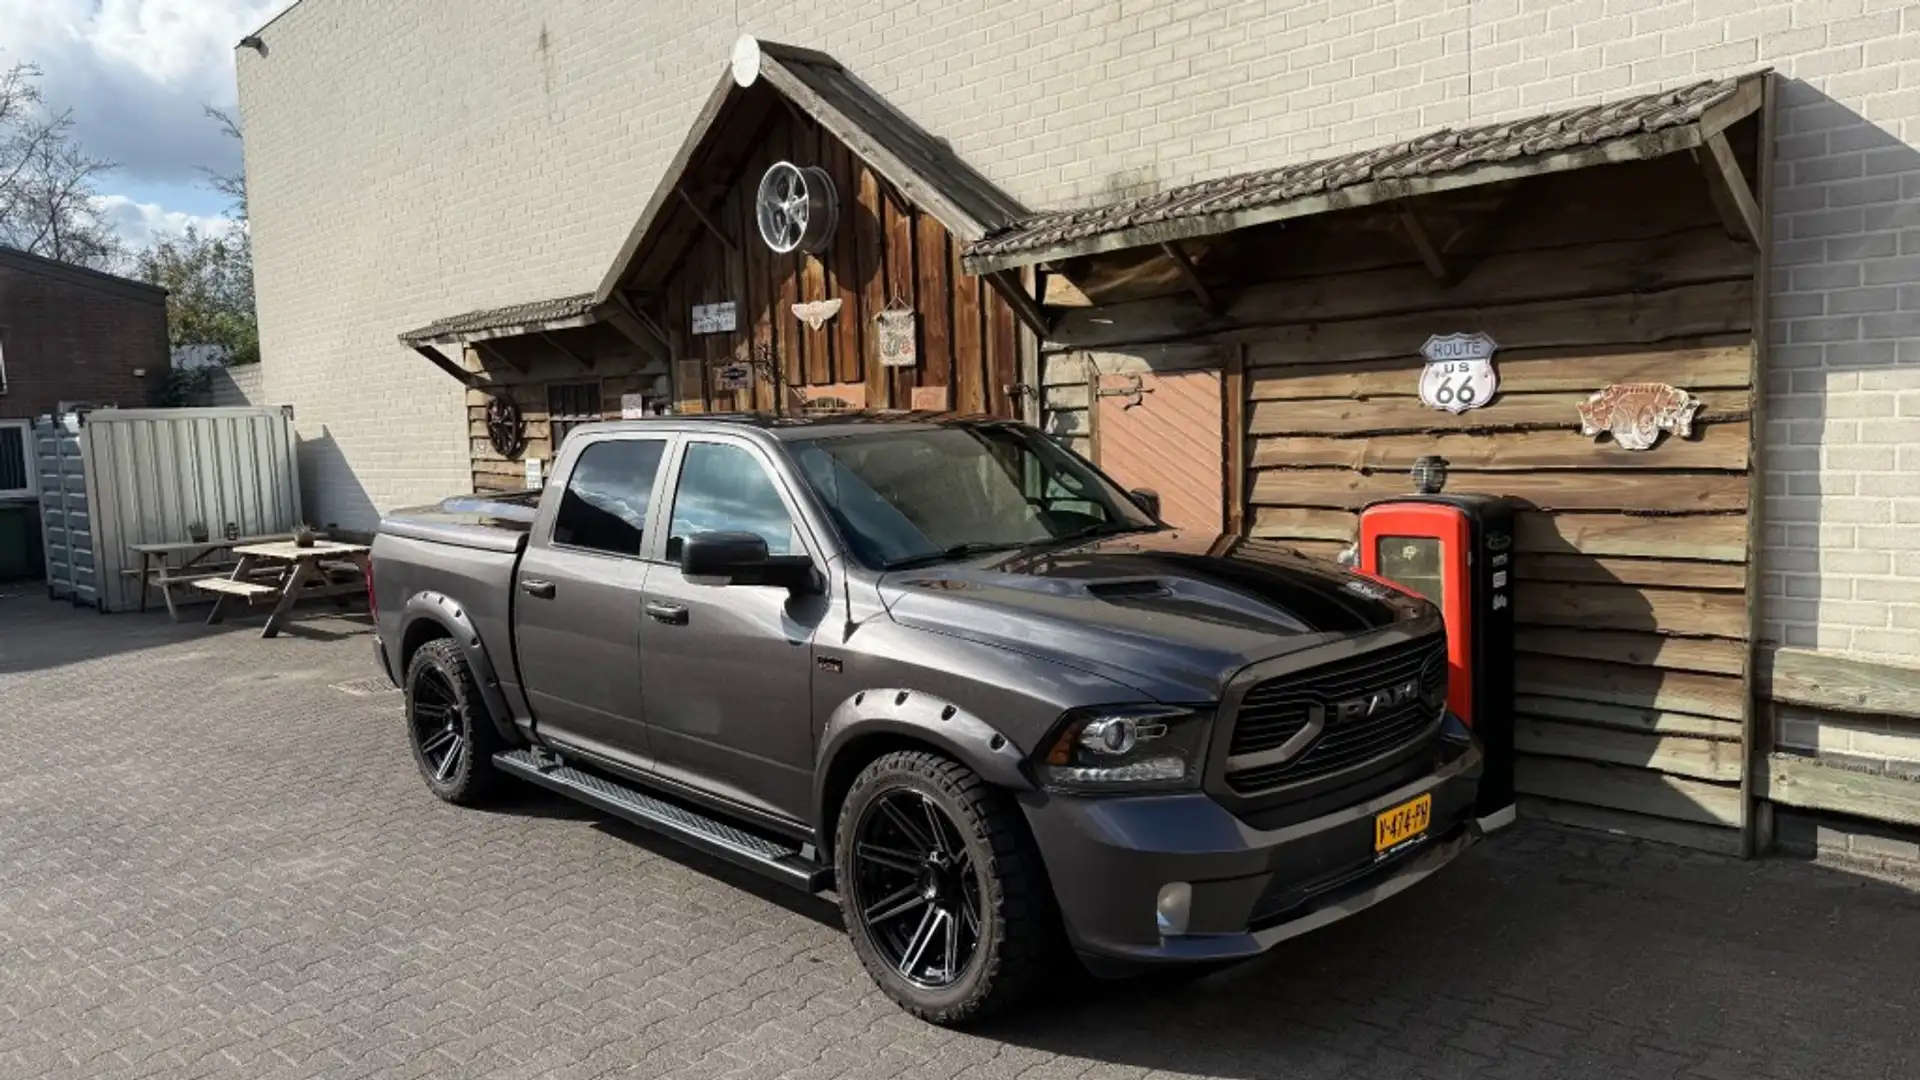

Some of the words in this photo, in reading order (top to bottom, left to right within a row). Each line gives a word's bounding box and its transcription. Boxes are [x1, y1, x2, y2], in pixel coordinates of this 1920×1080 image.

[1433, 341, 1481, 357] ROUTE
[1444, 362, 1470, 373] US
[1436, 375, 1475, 404] 66
[1337, 679, 1420, 722] RAM
